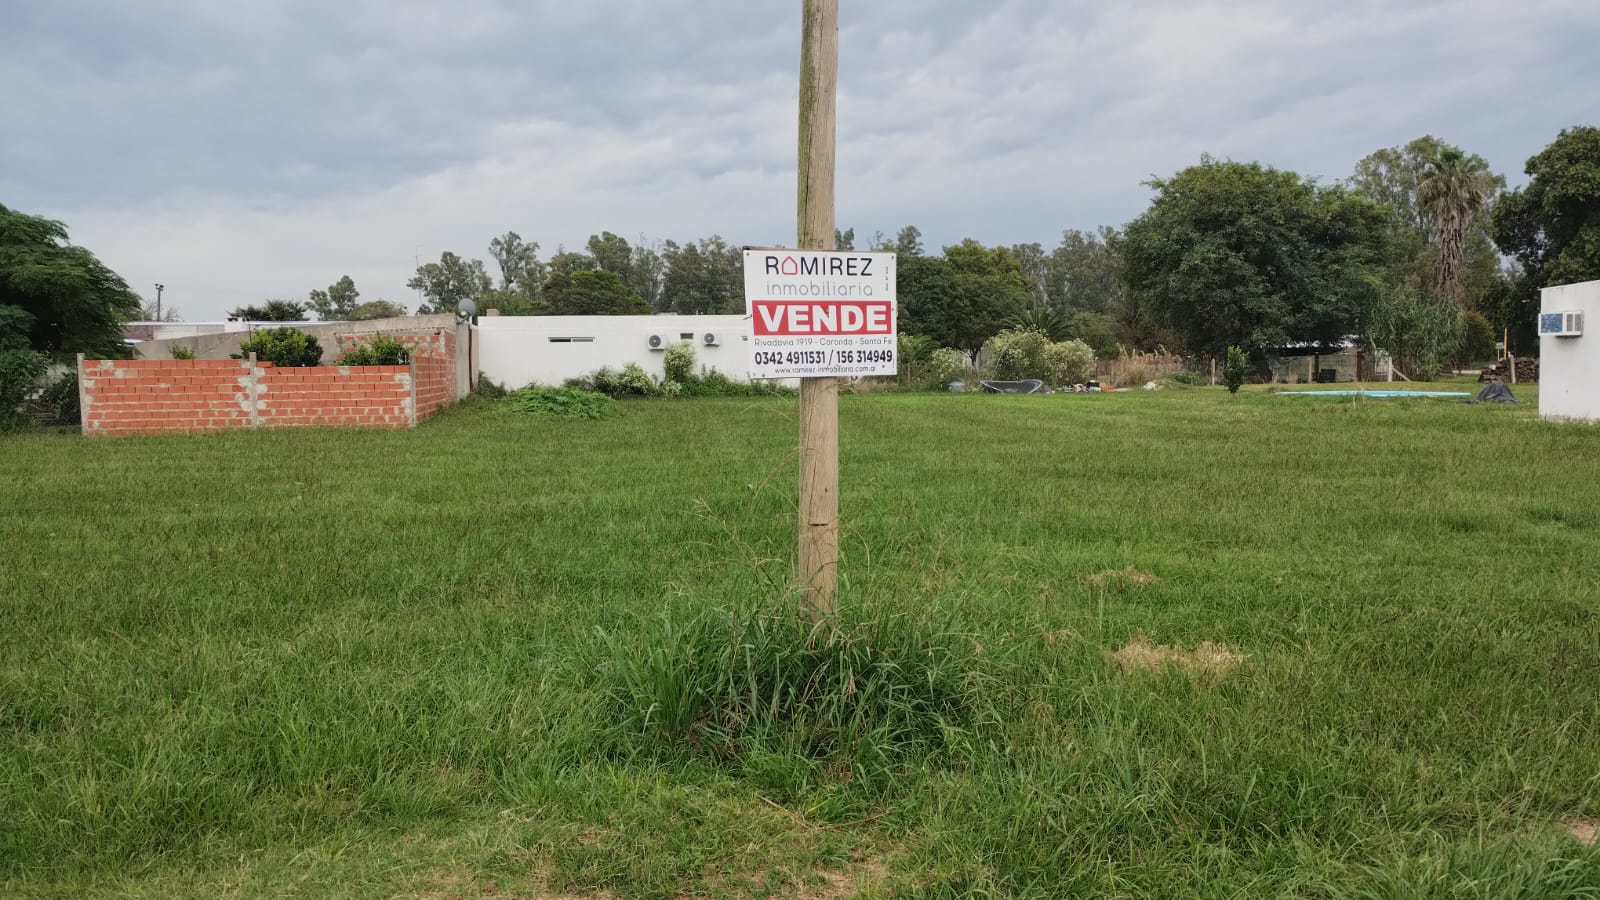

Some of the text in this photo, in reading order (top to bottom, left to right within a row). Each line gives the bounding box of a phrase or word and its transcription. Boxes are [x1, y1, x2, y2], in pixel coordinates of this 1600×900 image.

[766, 281, 873, 297] inmobiliaria
[757, 304, 888, 332] VENDE
[754, 338, 794, 346] Rivadavia
[796, 338, 813, 346] 1919
[820, 338, 853, 346] Coronda
[860, 337, 882, 345] Santa
[883, 336, 893, 344] Fe
[754, 351, 783, 365] 0342
[786, 350, 826, 364] 4911531
[836, 350, 854, 363] 156
[856, 350, 893, 362] 314949
